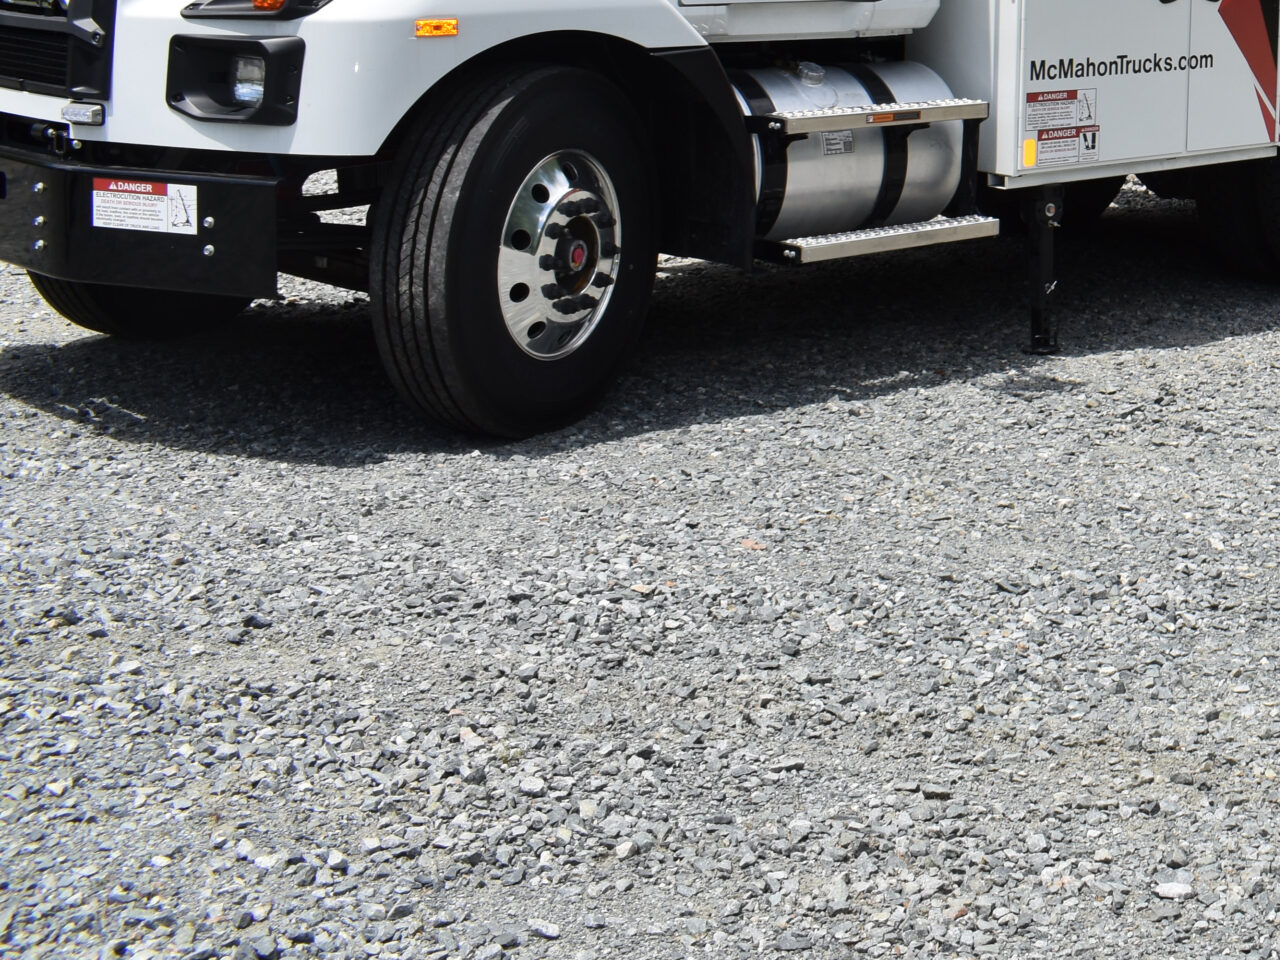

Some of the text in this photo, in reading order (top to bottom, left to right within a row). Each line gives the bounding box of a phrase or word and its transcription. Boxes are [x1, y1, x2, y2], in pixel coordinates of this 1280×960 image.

[1030, 53, 1214, 81] McMahonTrucks.com
[1043, 92, 1068, 100] DANGER
[1048, 128, 1077, 138] DANGER
[117, 182, 153, 193] DANGER
[95, 192, 165, 203] ELECTROCUTION HAZARD
